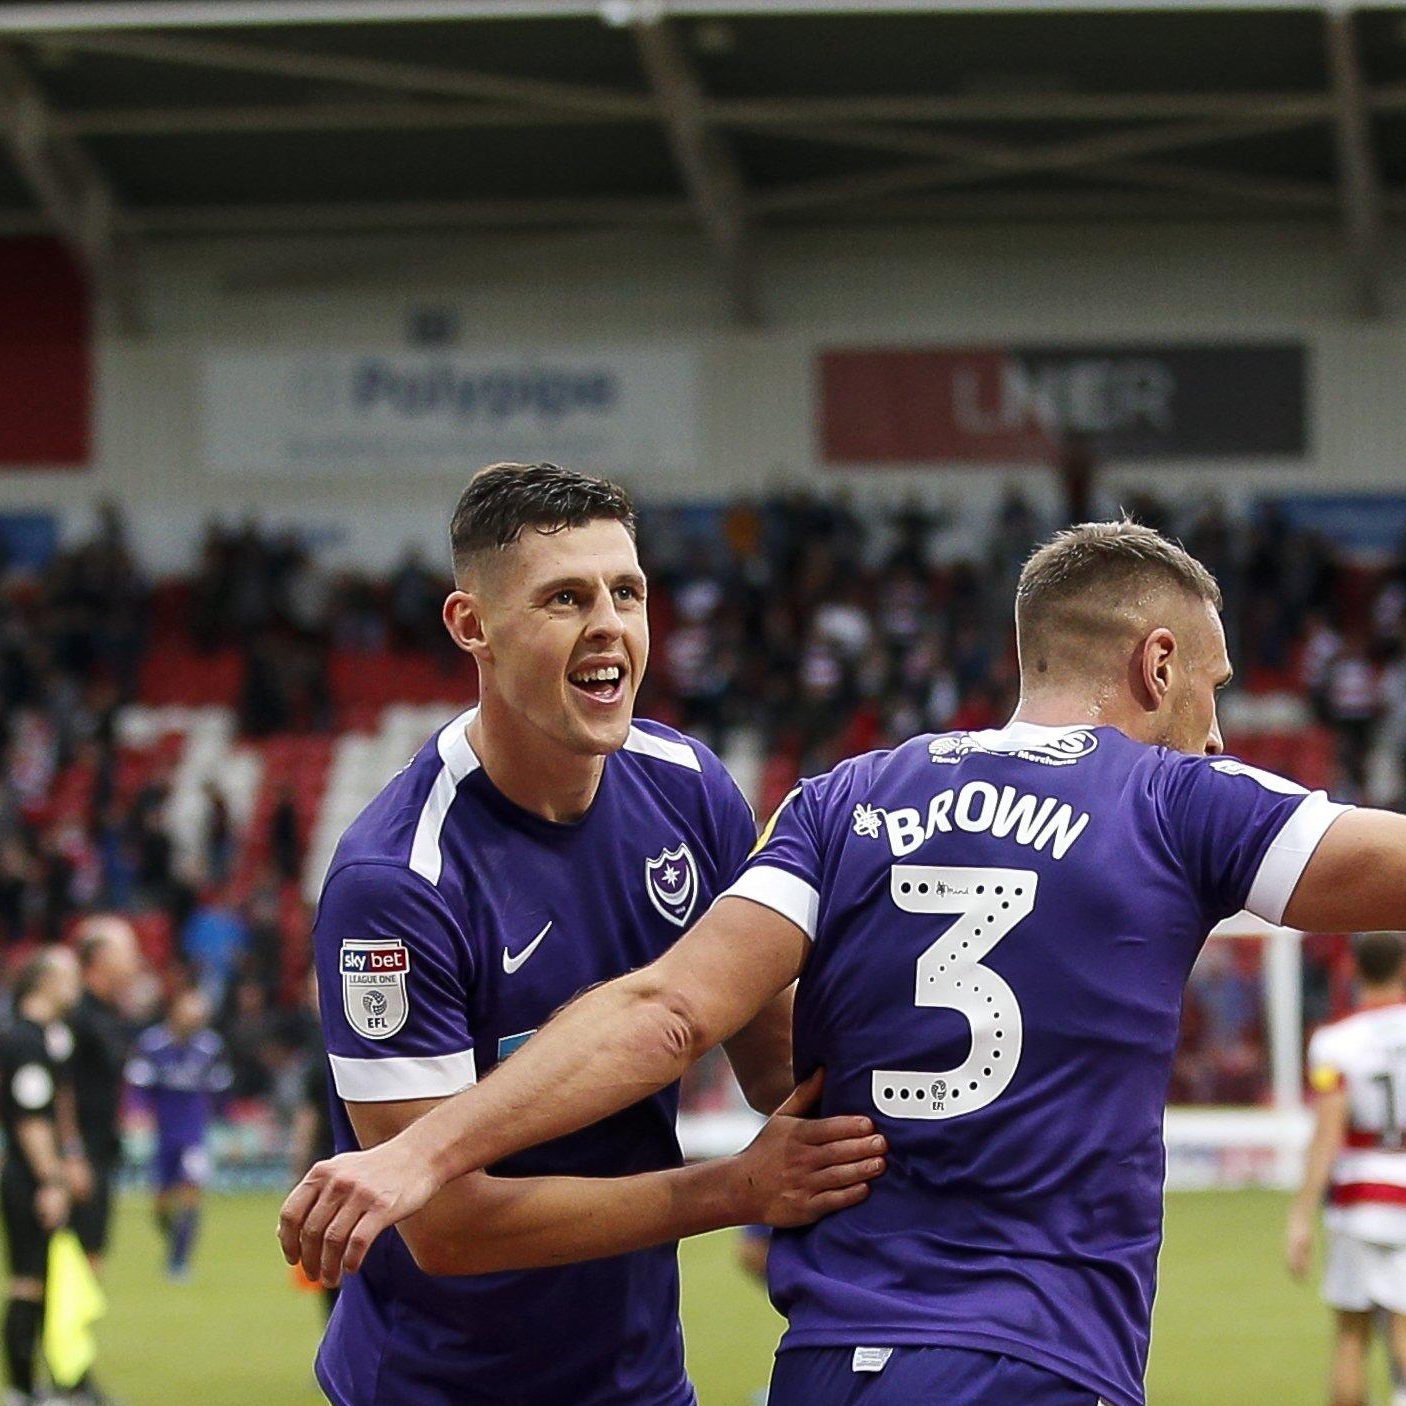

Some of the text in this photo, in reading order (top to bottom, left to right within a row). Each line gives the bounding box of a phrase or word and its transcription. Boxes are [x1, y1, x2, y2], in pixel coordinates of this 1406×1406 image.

[950, 358, 1175, 434] LNER
[884, 780, 1090, 860] BROWN
[345, 952, 403, 971] sky bet
[349, 974, 396, 984] LEAGUE ONE
[872, 865, 1038, 1119] 3
[367, 1017, 388, 1029] EFL
